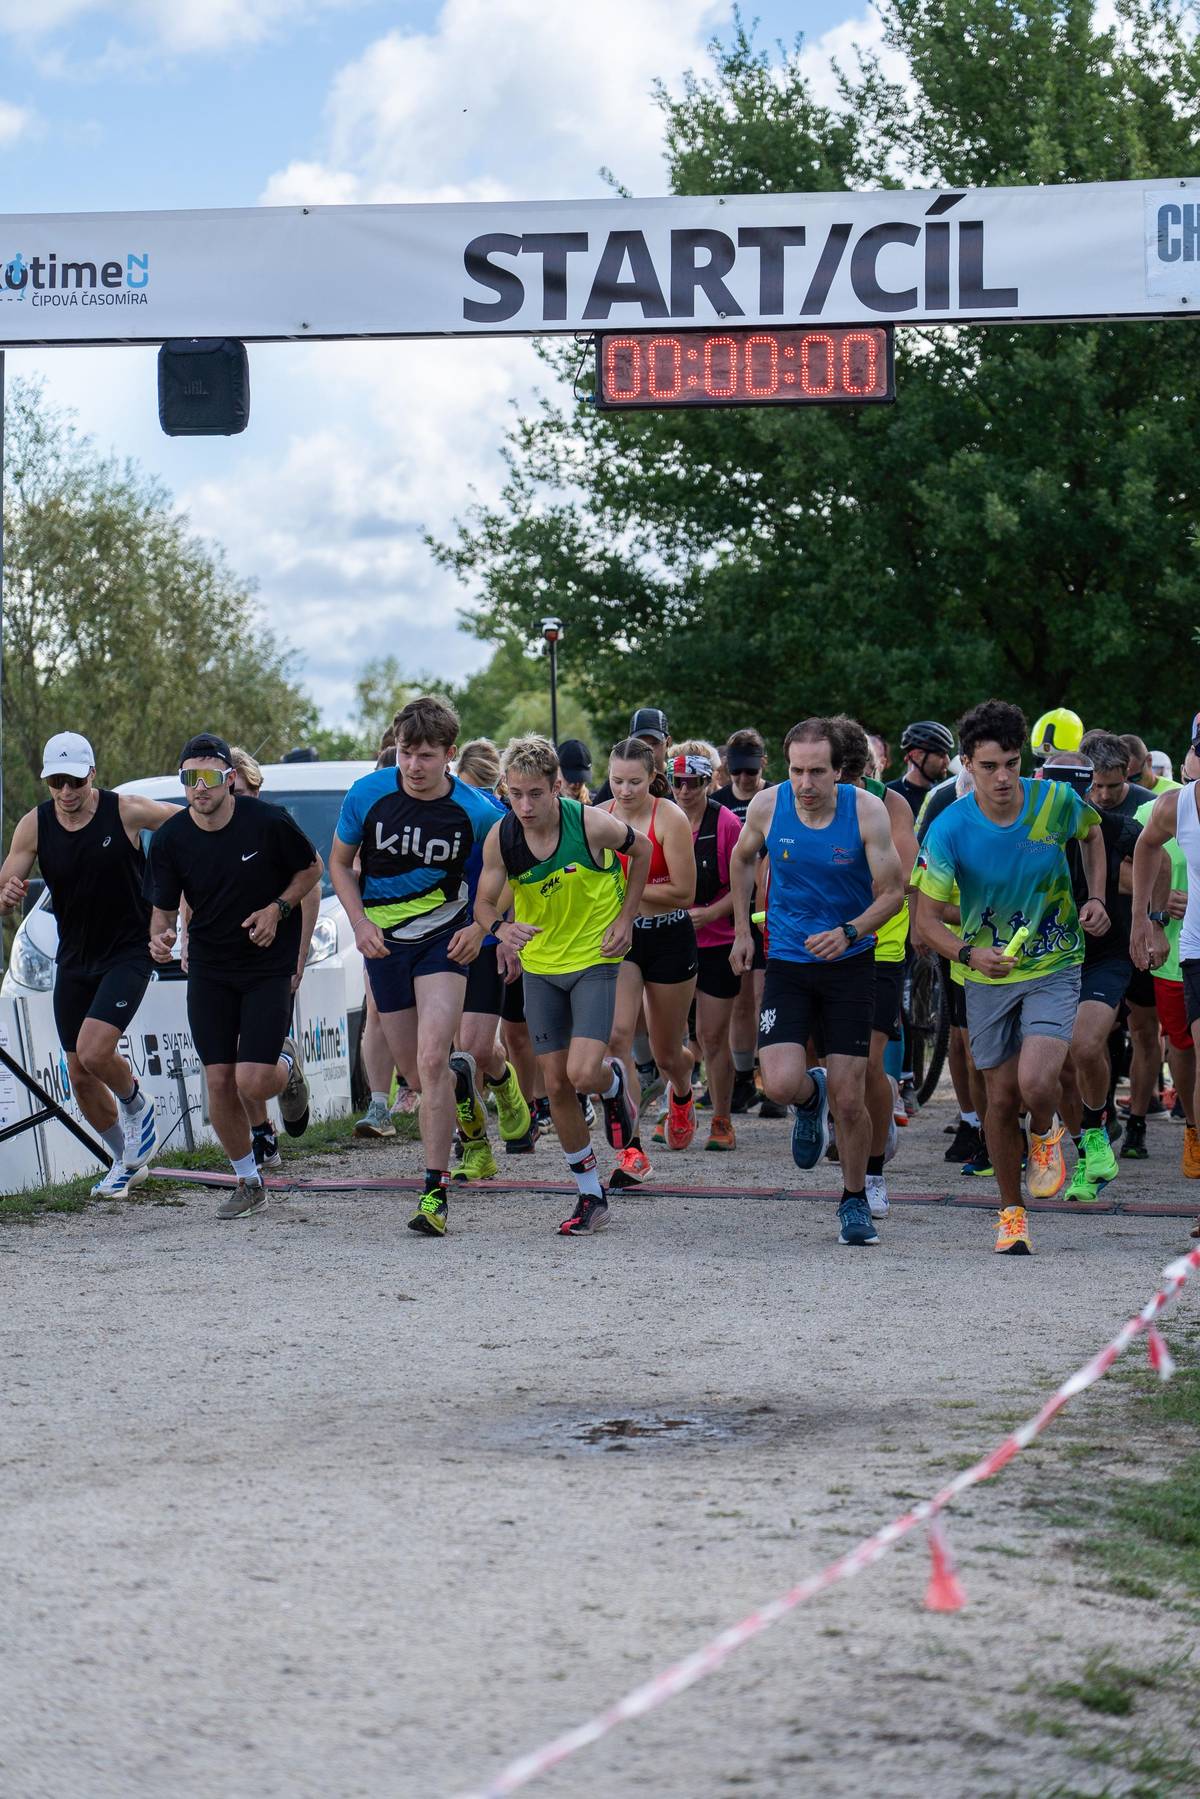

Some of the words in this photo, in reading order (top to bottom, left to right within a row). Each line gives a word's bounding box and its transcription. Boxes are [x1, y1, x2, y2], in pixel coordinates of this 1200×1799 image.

[463, 193, 1018, 323] START/CÍL
[32, 291, 78, 307] ČIPOVÁ
[81, 289, 148, 306] ČASOMÍRA
[608, 334, 876, 399] 00:00:00
[375, 821, 462, 865] kilpi
